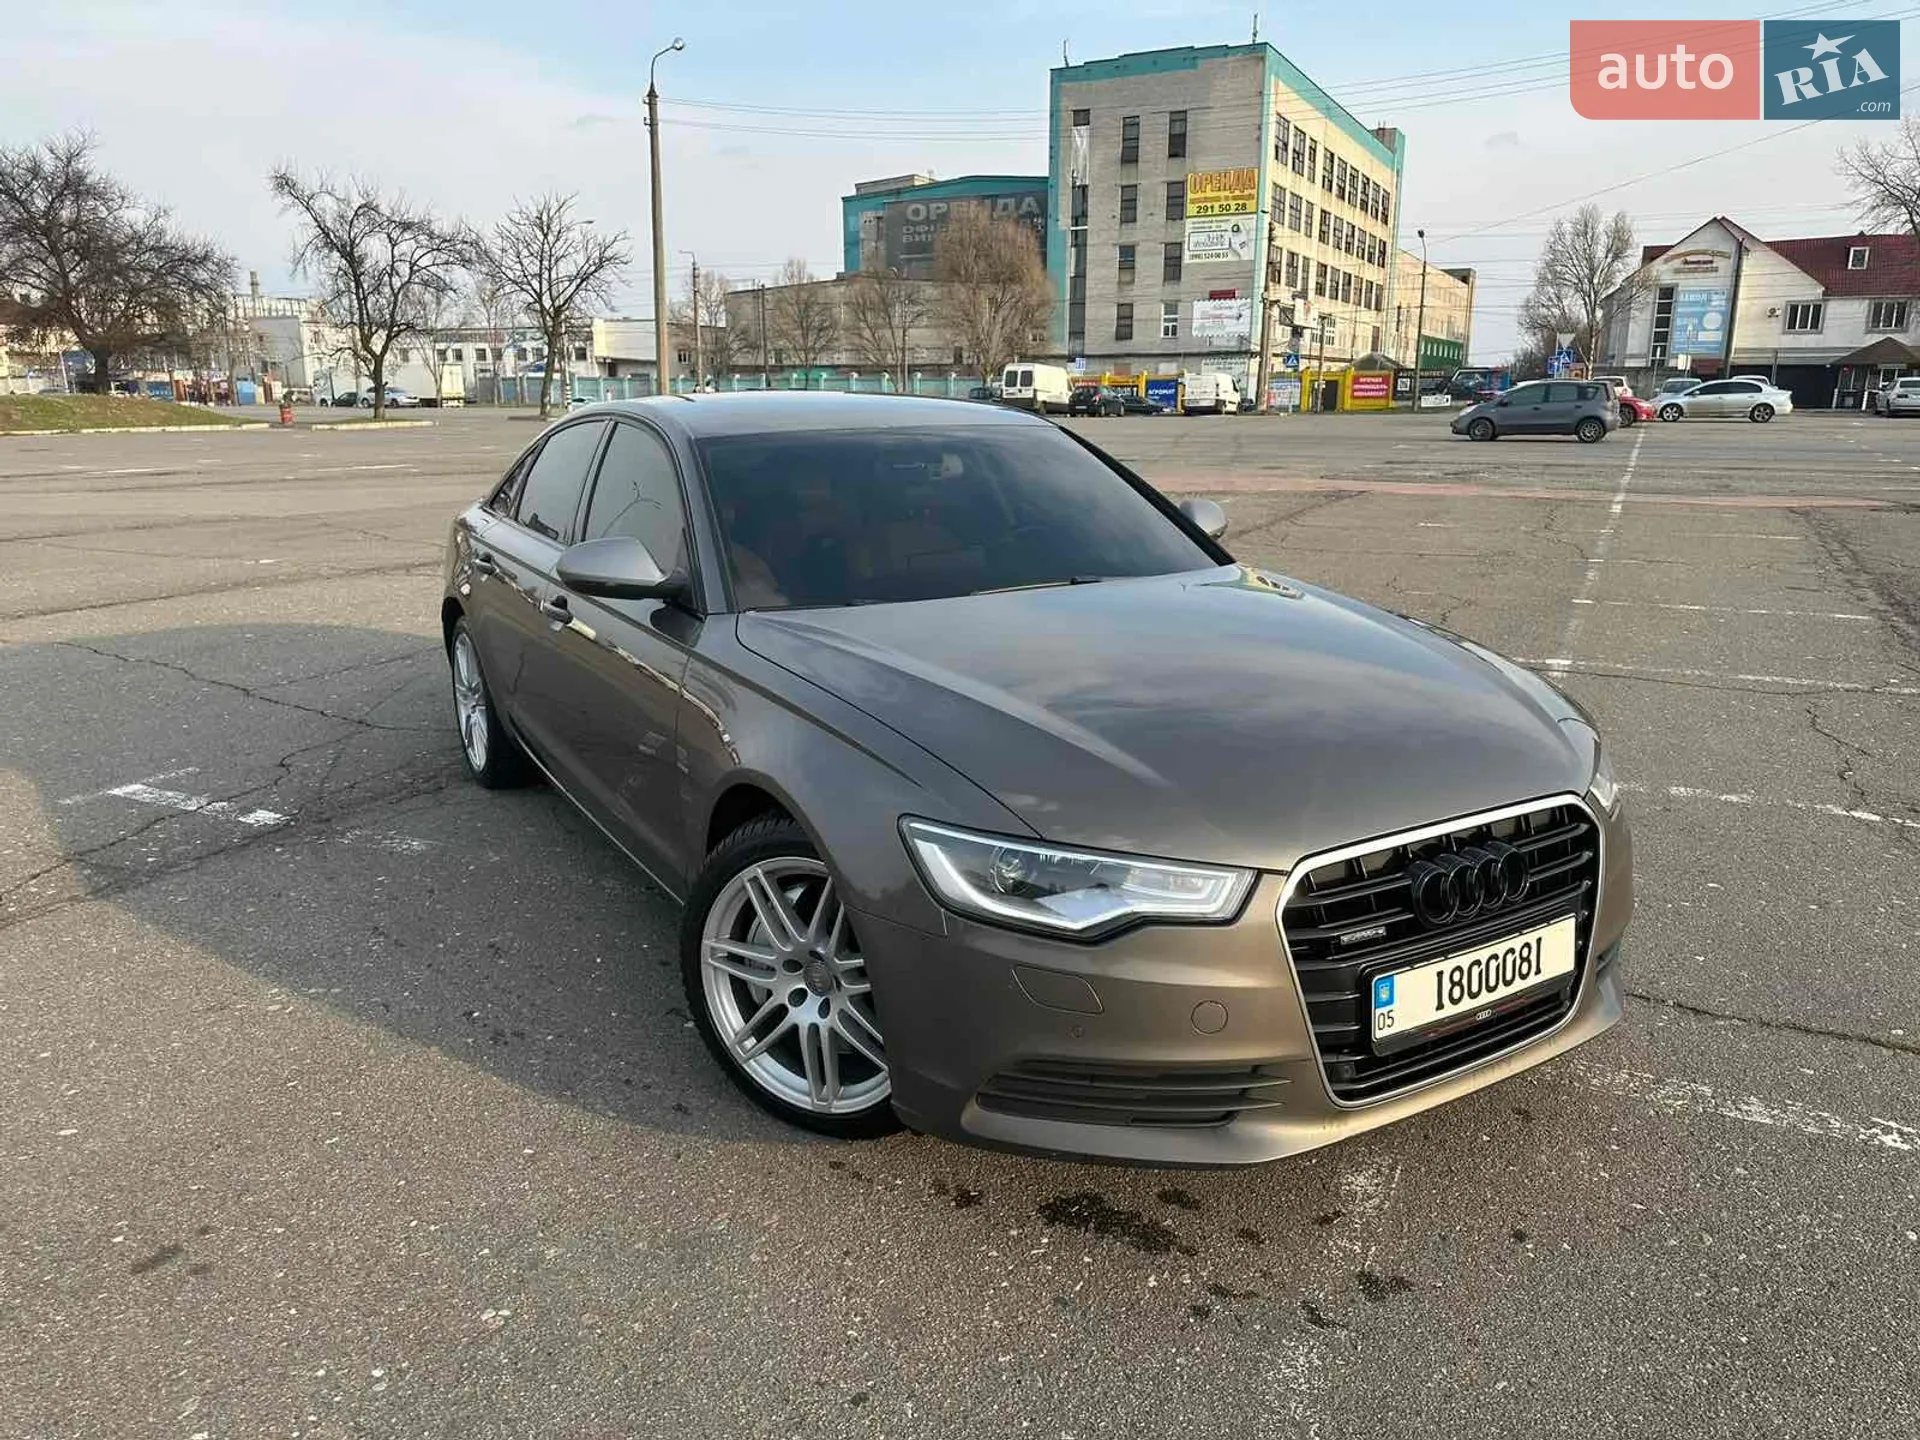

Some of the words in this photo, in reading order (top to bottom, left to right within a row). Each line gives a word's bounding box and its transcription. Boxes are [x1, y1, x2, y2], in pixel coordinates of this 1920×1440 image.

[1190, 169, 1256, 194] ОРЕНДА
[1196, 205, 1214, 214] 291
[1218, 203, 1231, 212] 50
[1234, 202, 1247, 211] 28
[1377, 1010, 1395, 1031] 05
